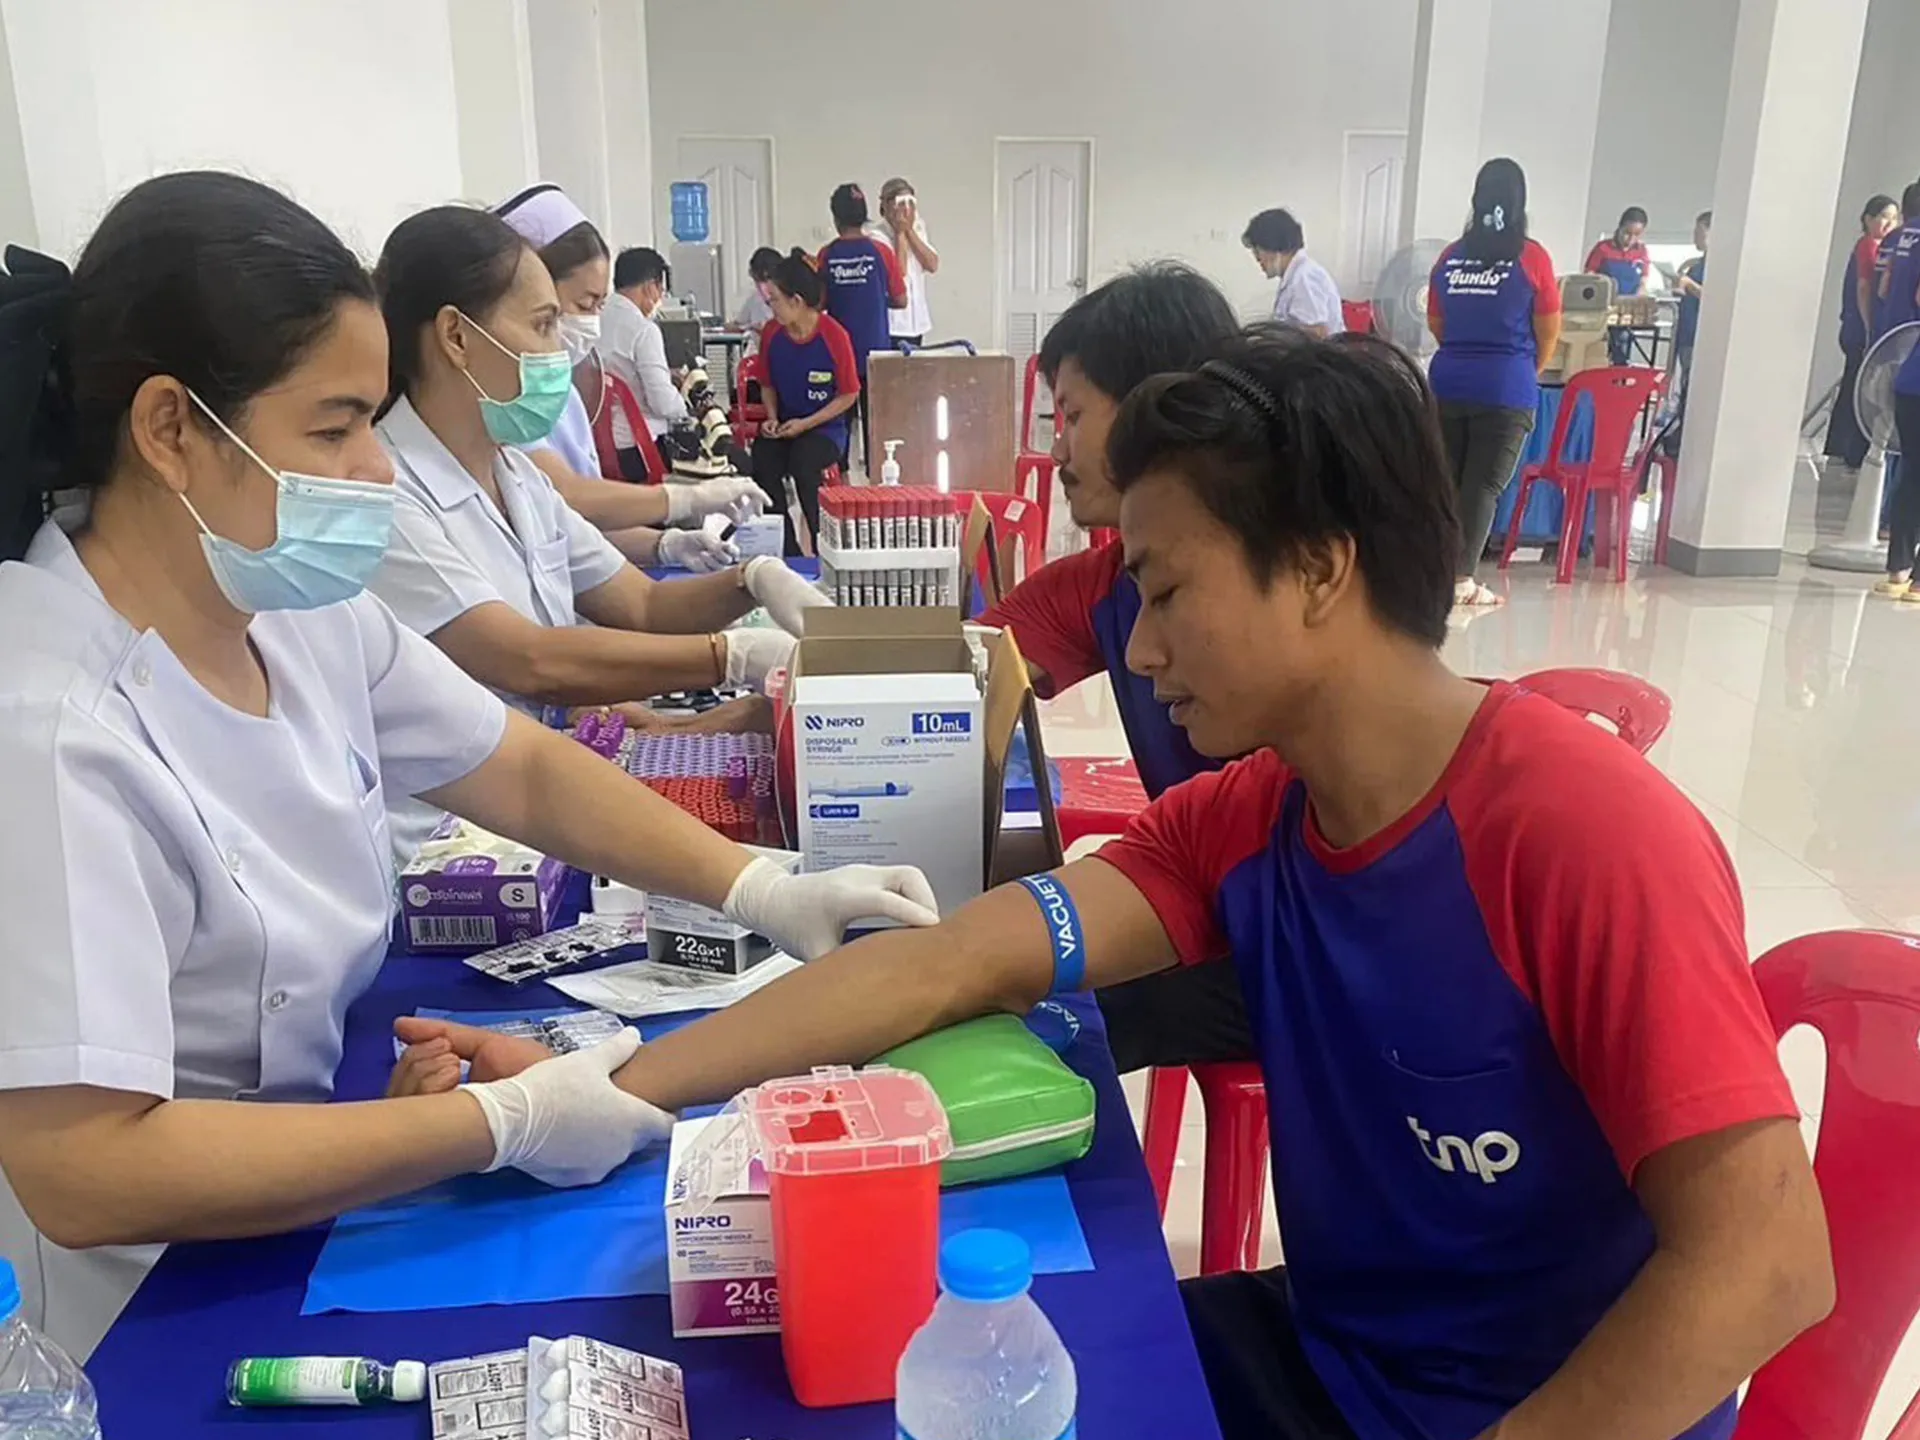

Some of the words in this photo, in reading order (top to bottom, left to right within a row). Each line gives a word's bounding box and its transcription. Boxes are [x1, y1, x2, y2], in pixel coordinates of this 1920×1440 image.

[808, 389, 828, 402] tnp
[826, 716, 865, 728] NIPRO
[918, 713, 965, 733] 10mL
[512, 888, 525, 902] S
[1406, 1115, 1521, 1184] tnp
[675, 1215, 731, 1229] NIPRO
[621, 1380, 634, 1415] ALSOFF
